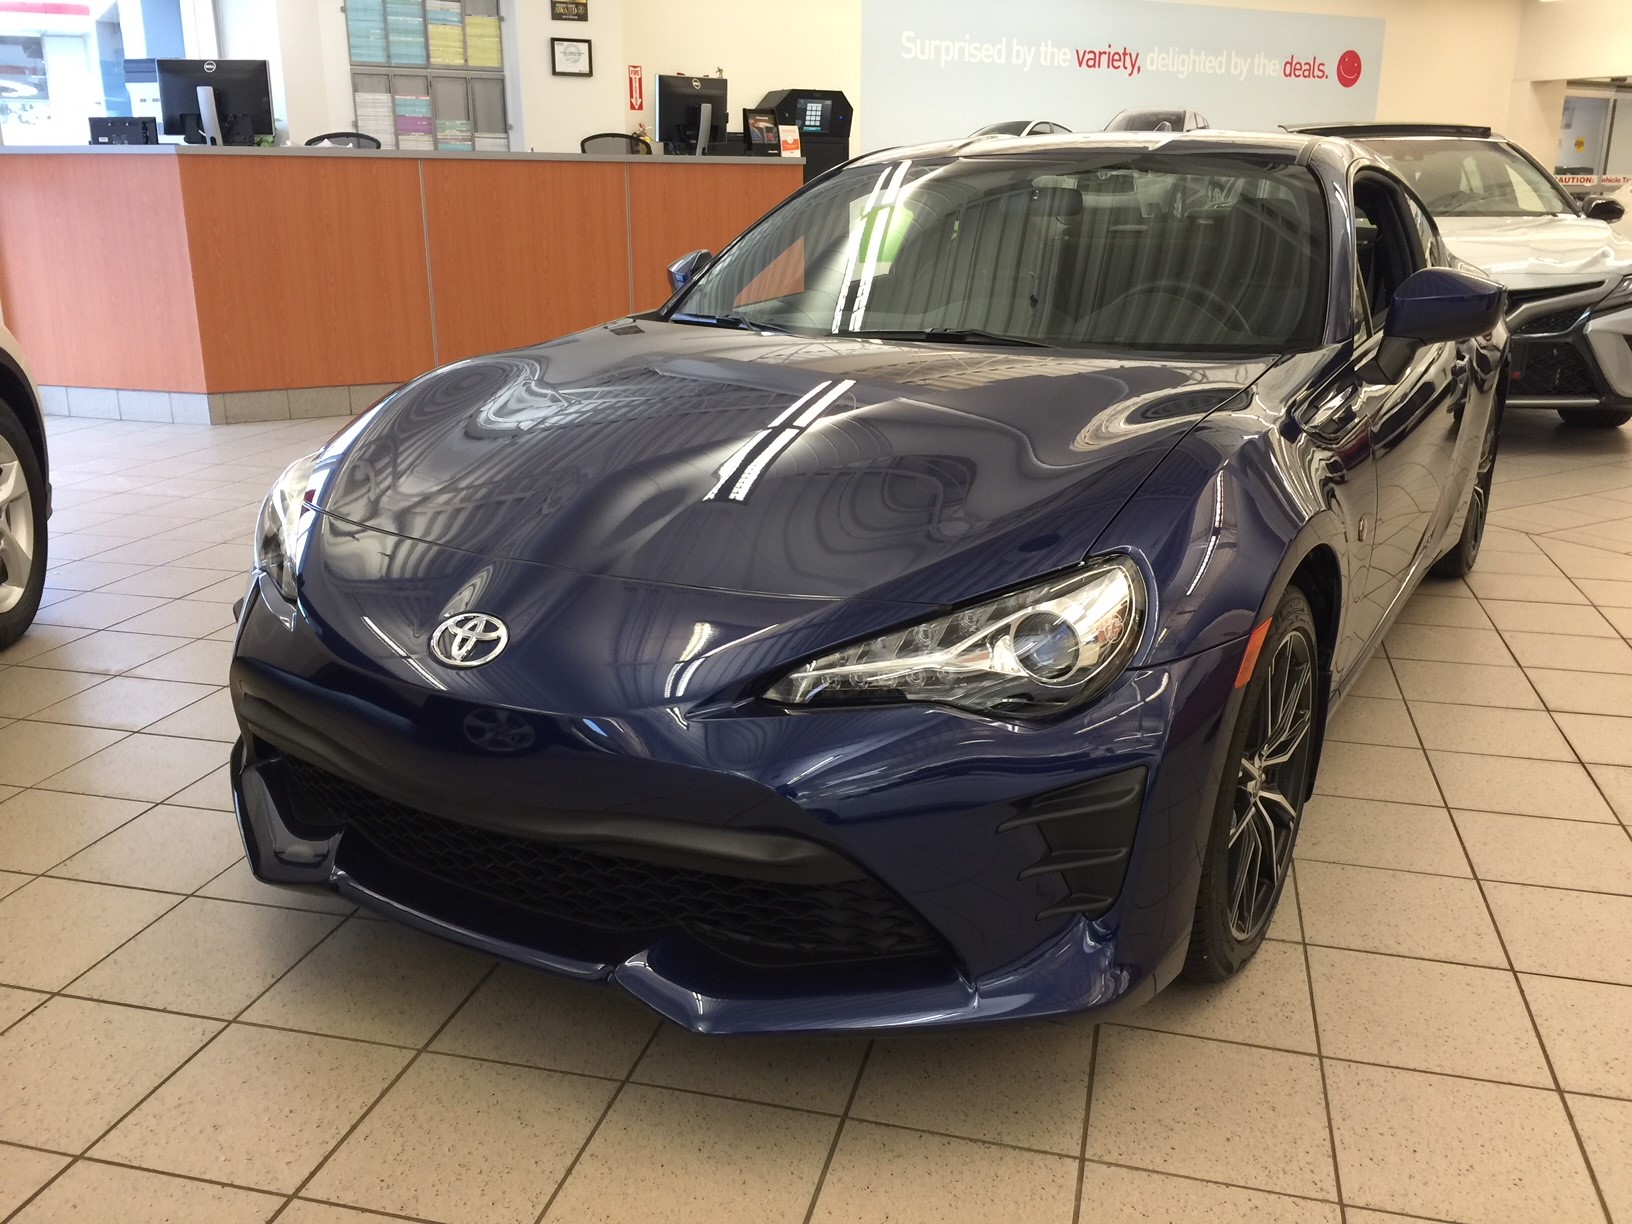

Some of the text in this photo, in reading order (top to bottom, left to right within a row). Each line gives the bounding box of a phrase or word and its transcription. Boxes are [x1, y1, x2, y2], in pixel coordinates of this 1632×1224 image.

[900, 30, 1329, 81] Surprised by the variety, delighted by the deals.
[1555, 176, 1632, 184] AUTION: ehicle Tr
